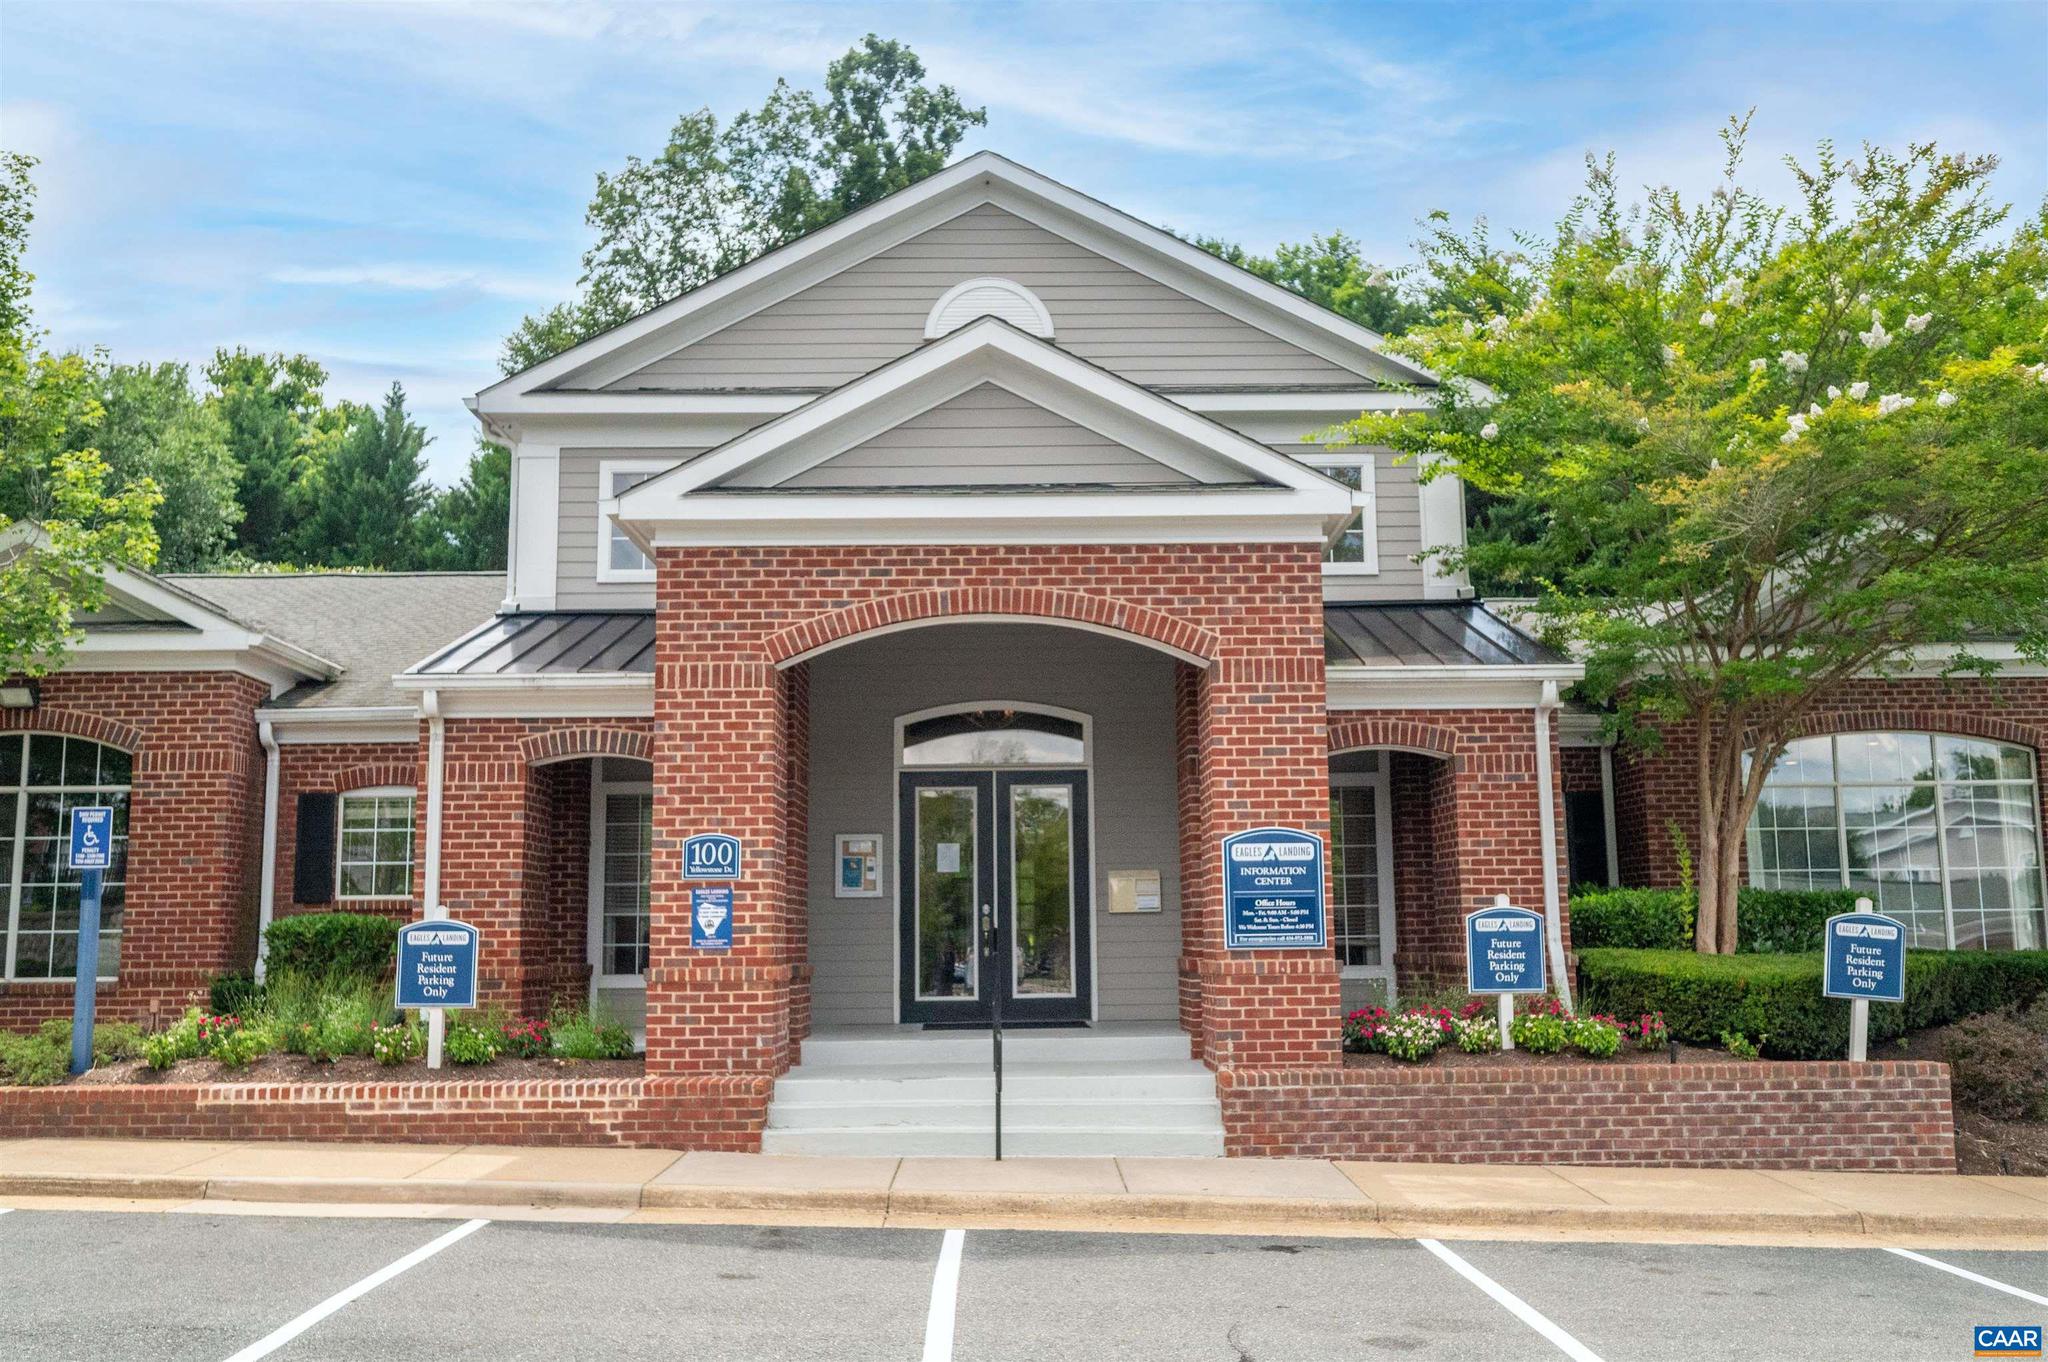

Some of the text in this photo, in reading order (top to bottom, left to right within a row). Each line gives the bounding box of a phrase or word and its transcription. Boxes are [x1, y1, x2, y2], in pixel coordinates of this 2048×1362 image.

[691, 842, 733, 865] 100
[1235, 846, 1311, 857] EAGLES LANDING
[690, 865, 723, 873] Yellowstone
[1240, 866, 1307, 876] INFORMATION
[1254, 876, 1293, 886] CENTER
[1255, 899, 1296, 907] Office Hours
[1839, 925, 1895, 936] EAGLES LANDING
[410, 933, 467, 941] EAGLES LANDING
[1491, 938, 1522, 948] Future
[1487, 949, 1526, 960] Resident
[1850, 943, 1882, 955] Future
[422, 951, 454, 963] Future
[1846, 955, 1885, 967] Resident
[416, 963, 457, 974] Resident
[1489, 961, 1525, 973] Parking
[1495, 972, 1520, 984] Only
[1847, 966, 1884, 980] Parking
[418, 975, 455, 988] Parking
[1852, 978, 1877, 991] Only
[423, 986, 448, 1000] Only
